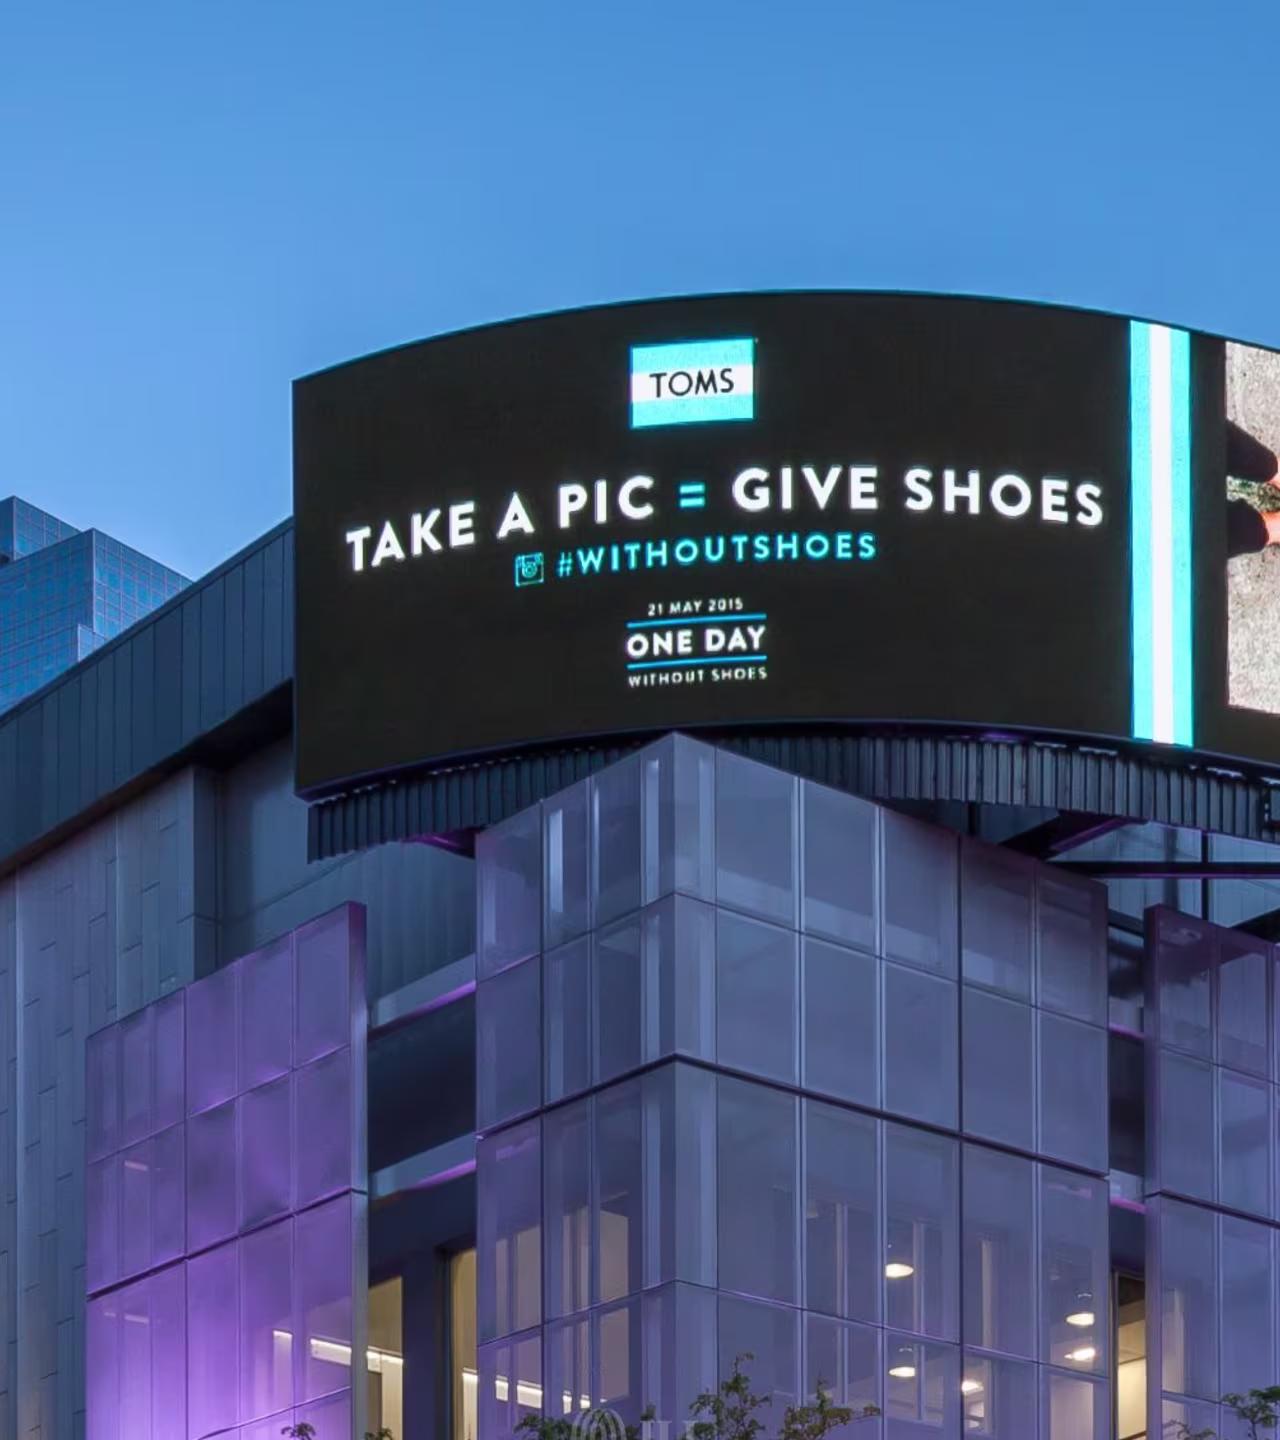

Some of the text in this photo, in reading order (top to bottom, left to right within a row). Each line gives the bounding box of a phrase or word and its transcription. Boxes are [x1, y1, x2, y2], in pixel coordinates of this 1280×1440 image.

[649, 368, 734, 398] TOMS
[345, 500, 476, 572] TAKE
[495, 491, 536, 540] A
[557, 475, 655, 529] PIC
[731, 464, 879, 512] GIVE
[903, 467, 1104, 527] SHOES
[556, 531, 877, 578] #WITHOUTSHOES
[647, 597, 743, 616] 21 MAY 2015
[626, 625, 766, 659] ONE DAY
[628, 666, 768, 688] WITHOUT SHOES
